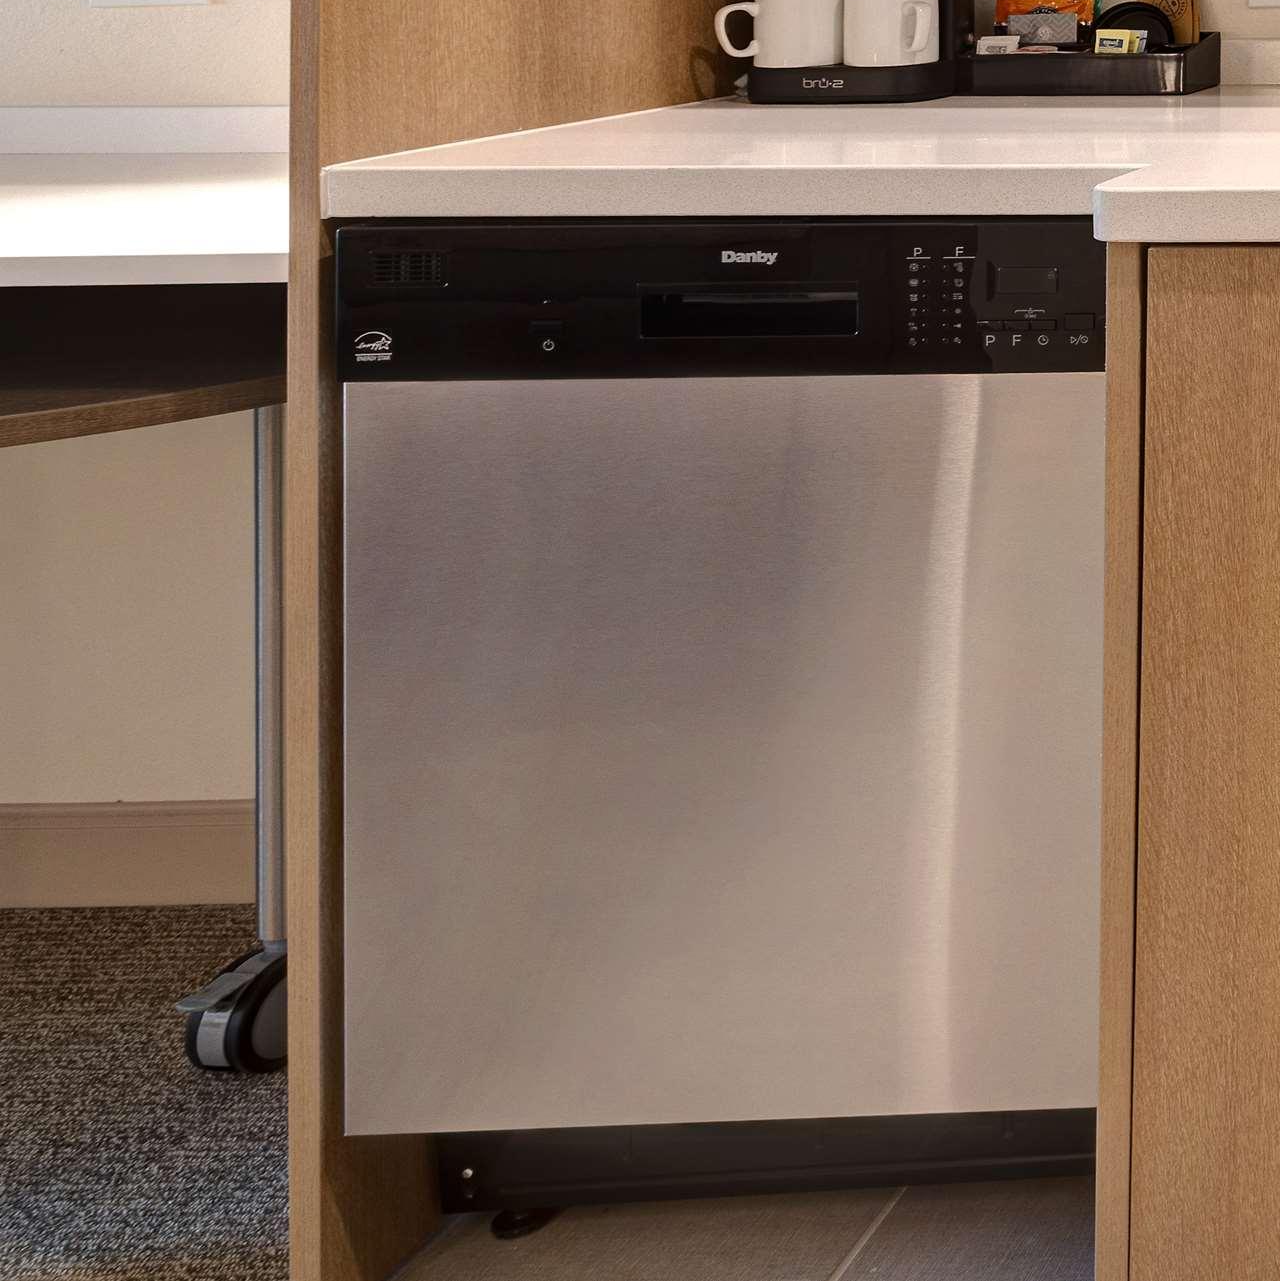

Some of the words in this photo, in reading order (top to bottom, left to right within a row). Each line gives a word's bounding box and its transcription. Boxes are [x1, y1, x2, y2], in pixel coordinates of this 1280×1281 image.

[913, 247, 923, 257] P
[955, 246, 964, 256] F
[721, 250, 778, 265] Danby
[985, 335, 996, 346] P
[1012, 334, 1022, 346] F
